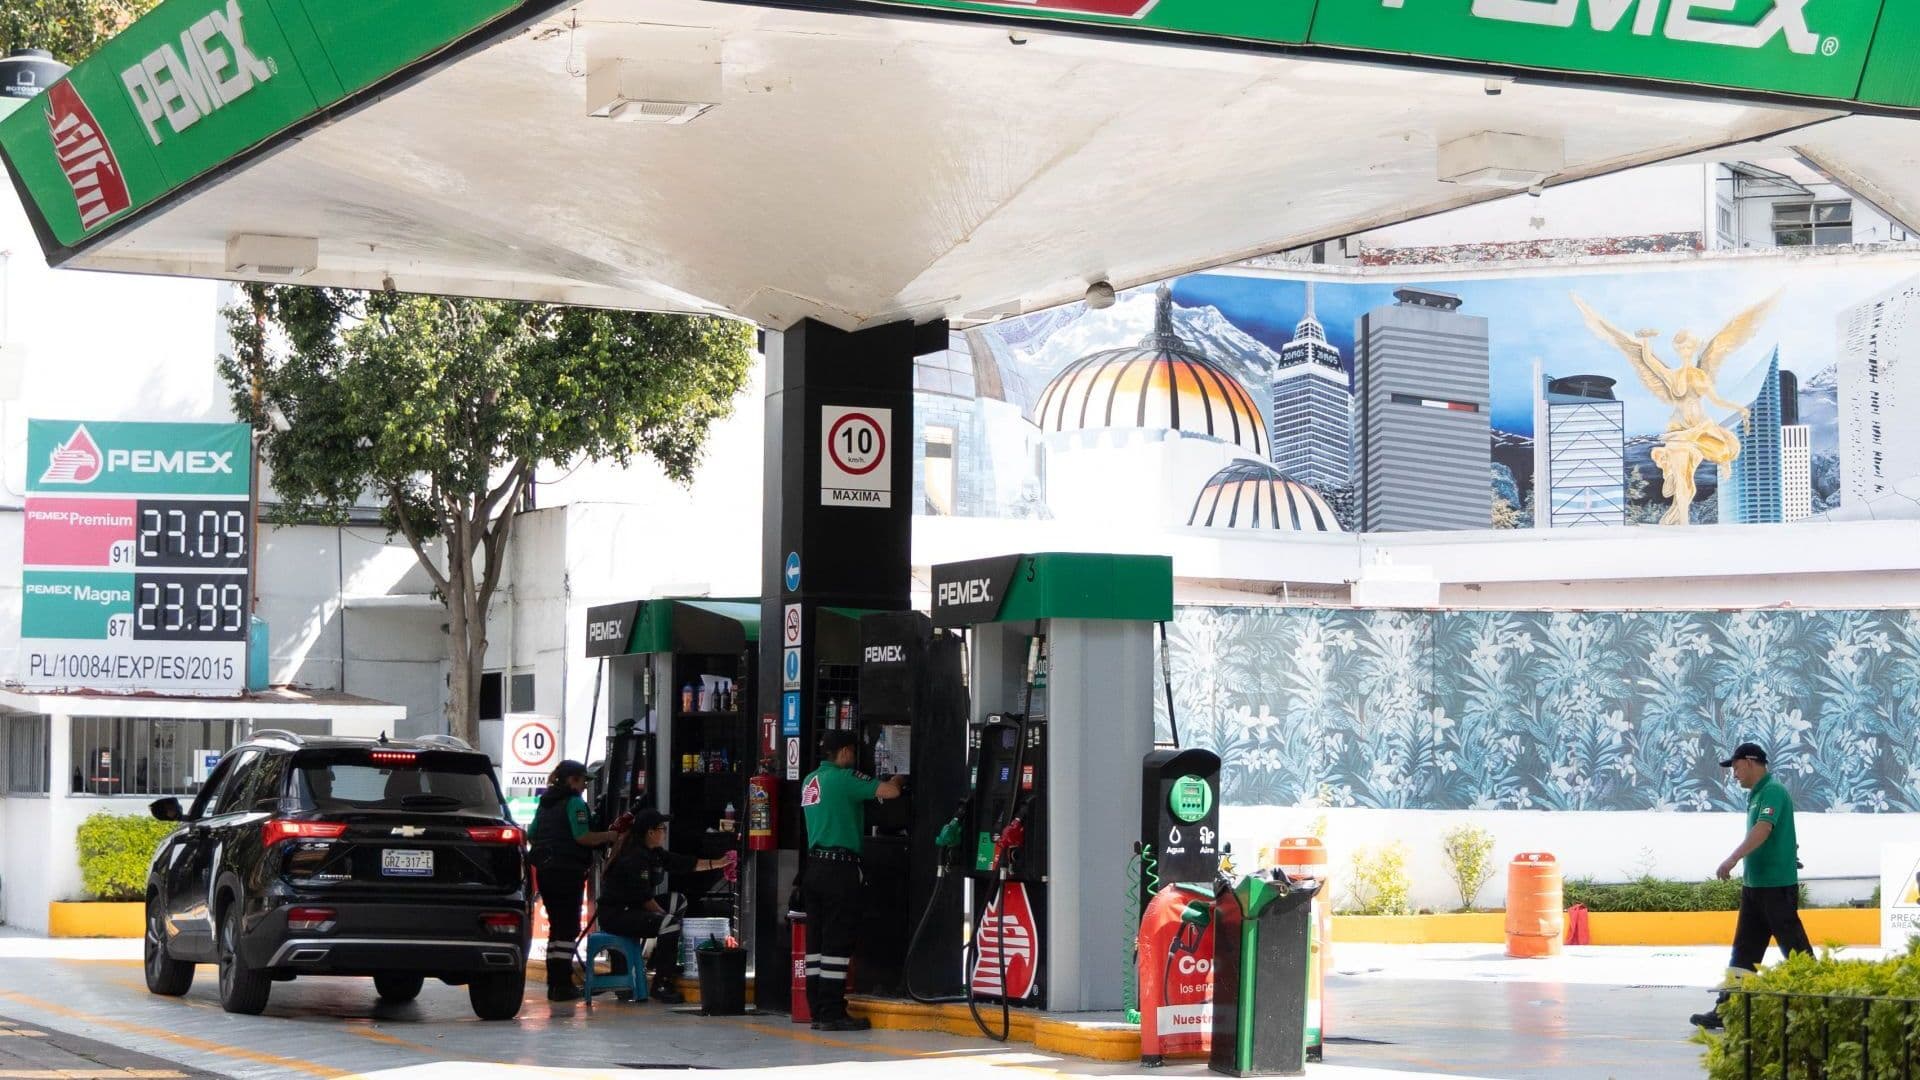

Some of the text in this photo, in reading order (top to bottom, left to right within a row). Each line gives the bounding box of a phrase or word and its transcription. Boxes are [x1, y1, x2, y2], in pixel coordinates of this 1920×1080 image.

[1381, 0, 1819, 55] MEX
[120, 0, 272, 146] PEMEX
[842, 427, 872, 454] 10
[108, 449, 233, 474] PEMEX
[832, 490, 881, 502] MAXIMA
[28, 511, 133, 527] PEMEX Premium
[113, 546, 129, 563] 91
[1027, 557, 1036, 583] 3
[26, 584, 131, 605] PEMEX Magna
[938, 578, 991, 606] PEMEX
[138, 582, 242, 632] 23.99
[109, 619, 126, 636] 87
[589, 619, 622, 642] PEMEX
[865, 645, 902, 663] PEMEX
[30, 654, 234, 680] PL/10084/EXP/ES/2015
[522, 732, 545, 749] 10
[512, 776, 547, 785] MAXIM
[1166, 847, 1185, 855] Agua
[1890, 913, 1920, 921] PREC
[1180, 983, 1194, 994] los
